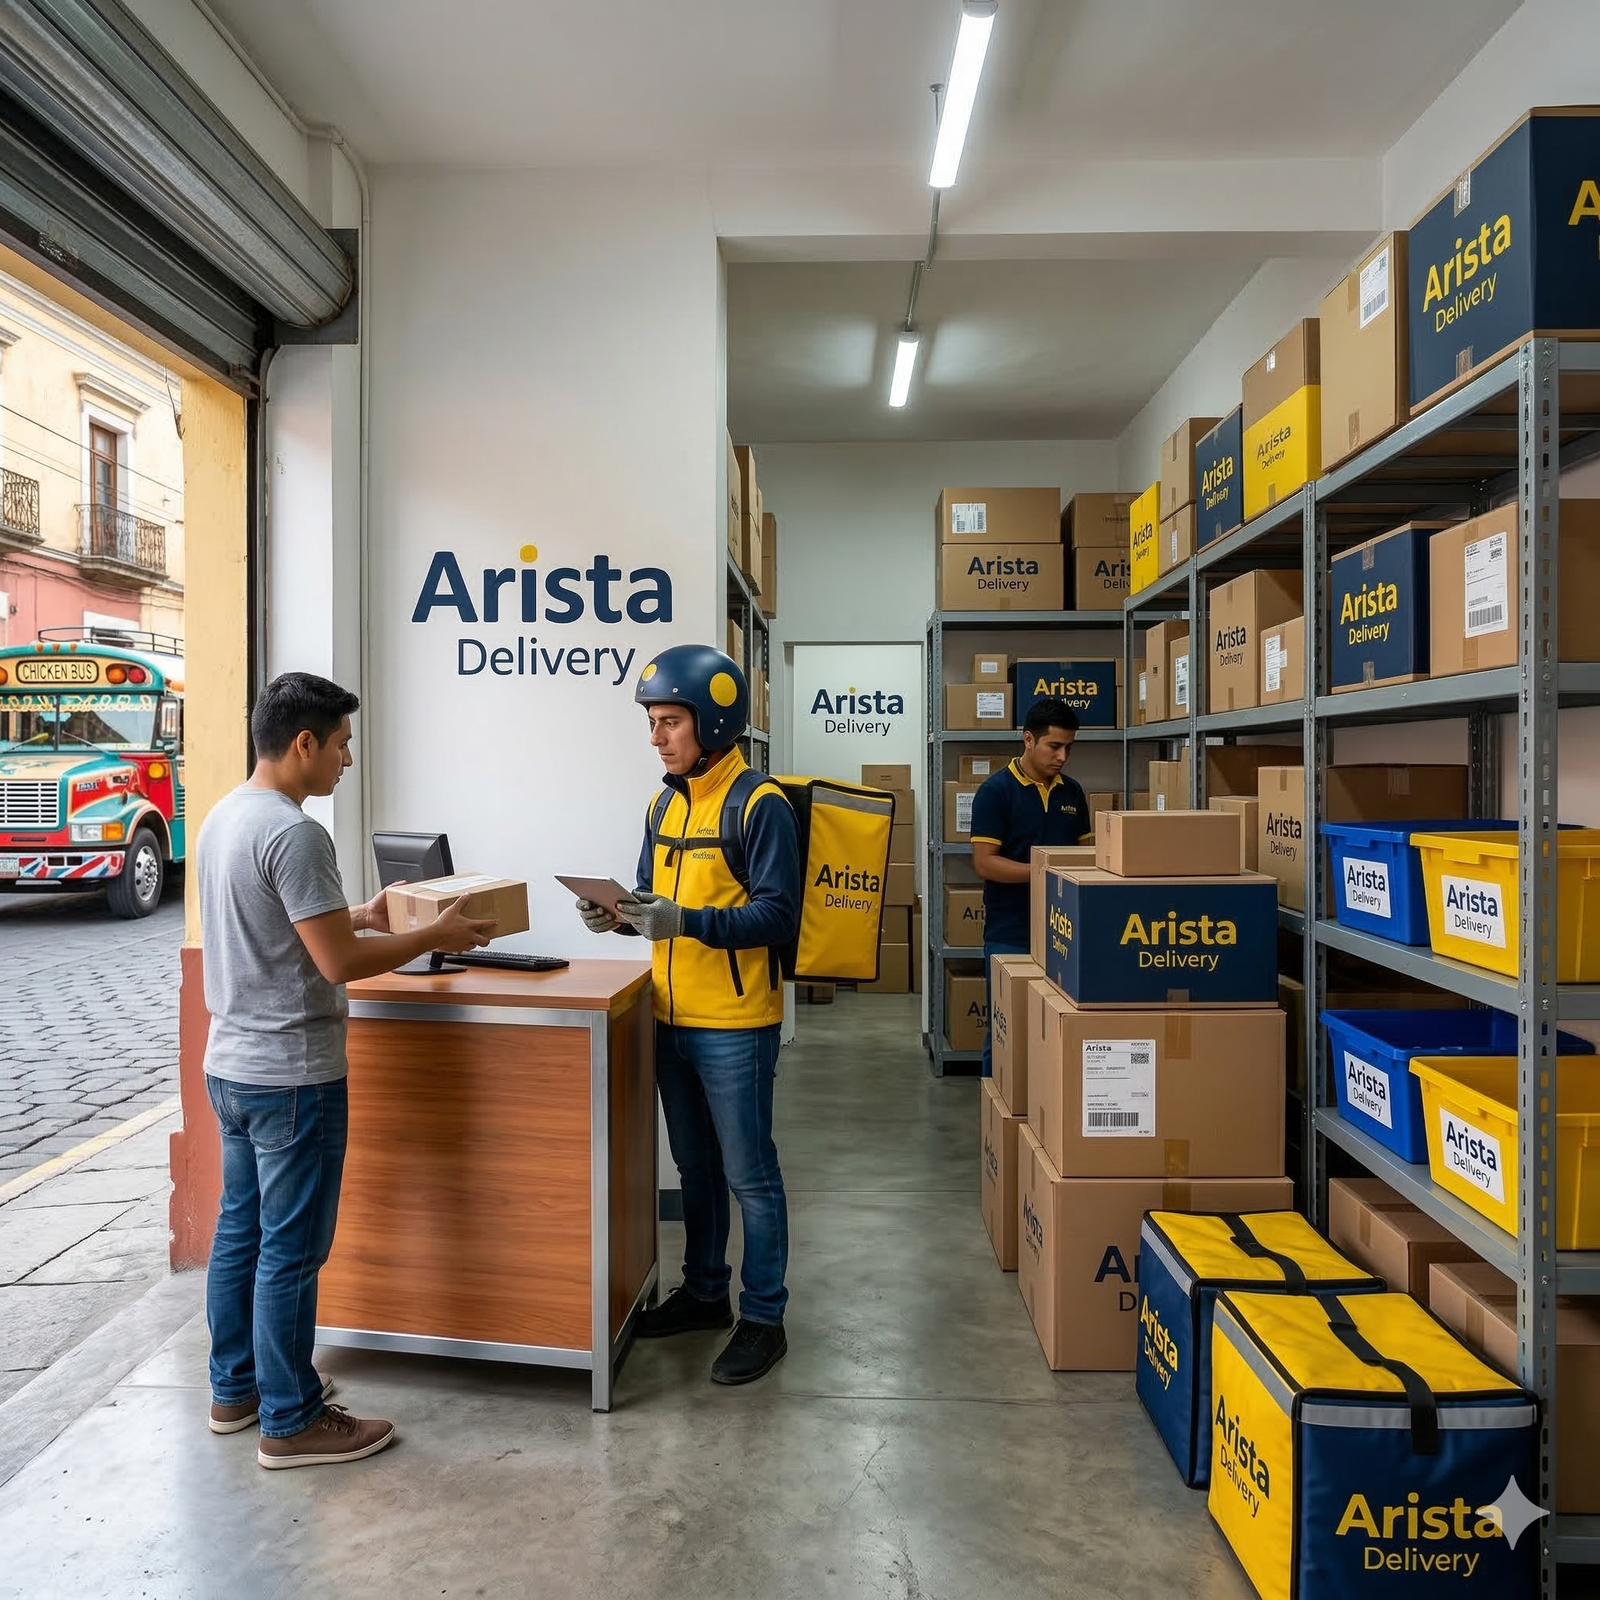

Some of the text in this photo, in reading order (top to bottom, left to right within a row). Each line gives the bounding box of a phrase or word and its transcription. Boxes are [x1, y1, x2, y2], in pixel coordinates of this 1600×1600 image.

[1422, 213, 1511, 313] Arista
[1435, 272, 1497, 333] Delivery
[1256, 426, 1291, 461] Arista
[1201, 456, 1233, 497] Arista
[1132, 521, 1153, 550] Arista
[967, 555, 1039, 576] Arista
[411, 543, 673, 624] Arista
[977, 577, 1030, 592] Delivery
[1340, 582, 1398, 625] Arista
[1215, 625, 1247, 652] Arista
[1349, 622, 1390, 645] Delivery
[22, 663, 92, 680] CHICKEN BUS
[457, 636, 636, 686] Delivery
[810, 686, 904, 715] Arista
[1033, 677, 1098, 696] Arista
[825, 718, 891, 737] Delivery
[1266, 812, 1302, 839] Arista
[1270, 840, 1298, 862] Delivery
[813, 863, 880, 893] Arista
[1346, 865, 1386, 892] Arista
[825, 893, 873, 914] Delivery
[1352, 889, 1382, 911] Delivery
[1446, 884, 1499, 917] Arista
[1049, 903, 1073, 941] Arista
[1119, 910, 1237, 946] Arista
[1454, 914, 1492, 939] Delivery
[1139, 951, 1219, 971] Delivery
[1085, 1044, 1112, 1052] Arista
[1348, 1060, 1386, 1101] Arista
[1446, 1120, 1498, 1172] Arista
[1140, 1295, 1178, 1372] Arista
[1215, 1394, 1270, 1500] Arista
[1220, 1443, 1260, 1518] Delivery
[1335, 1491, 1503, 1540] Arista
[1364, 1546, 1480, 1577] Delivery
